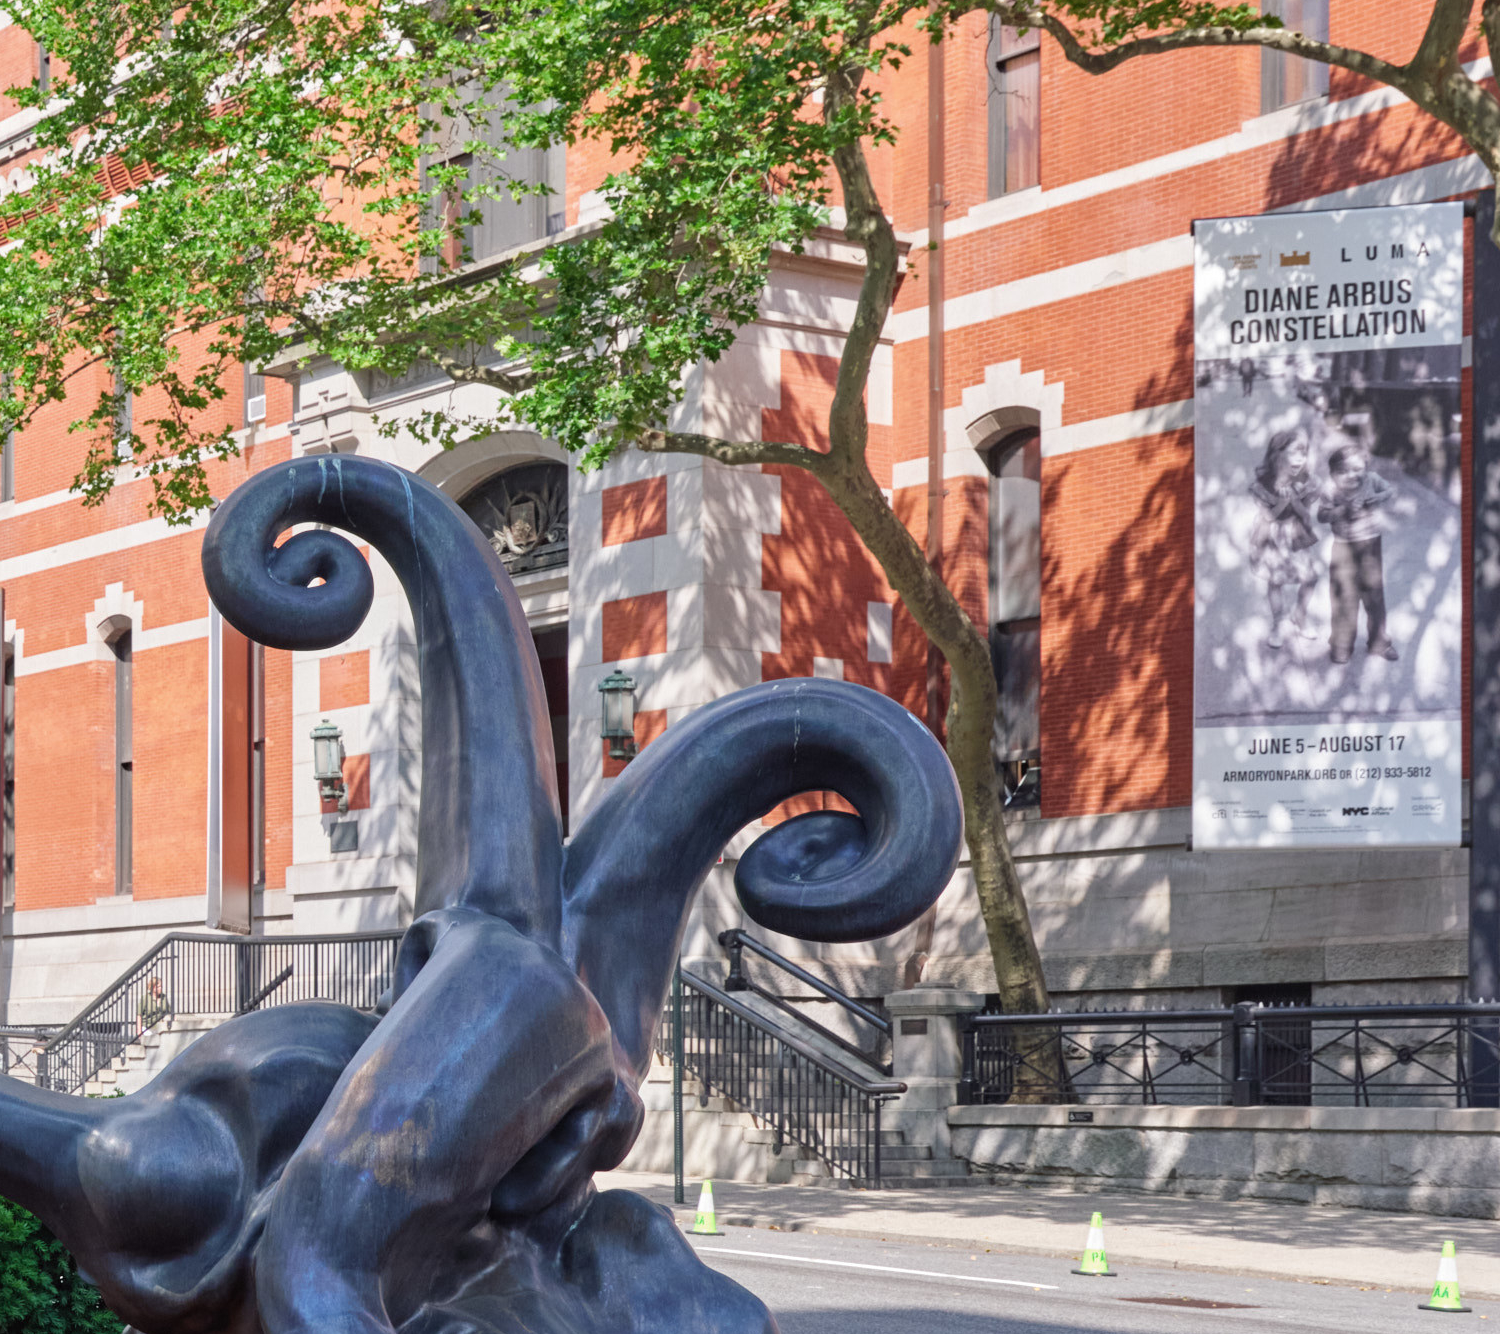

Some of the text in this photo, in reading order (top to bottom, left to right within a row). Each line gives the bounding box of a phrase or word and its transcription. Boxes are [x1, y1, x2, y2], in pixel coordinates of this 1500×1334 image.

[1245, 279, 1413, 314] DIANE ARBUS
[1230, 309, 1427, 345] CONSTELLATION
[1248, 738, 1291, 755] JUNE
[1388, 736, 1405, 751] 17
[1224, 768, 1336, 782] ARMORYONPARK.ORG
[1355, 767, 1382, 781] (212)
[1384, 767, 1431, 779] 933-5812
[1342, 807, 1369, 816] NYC
